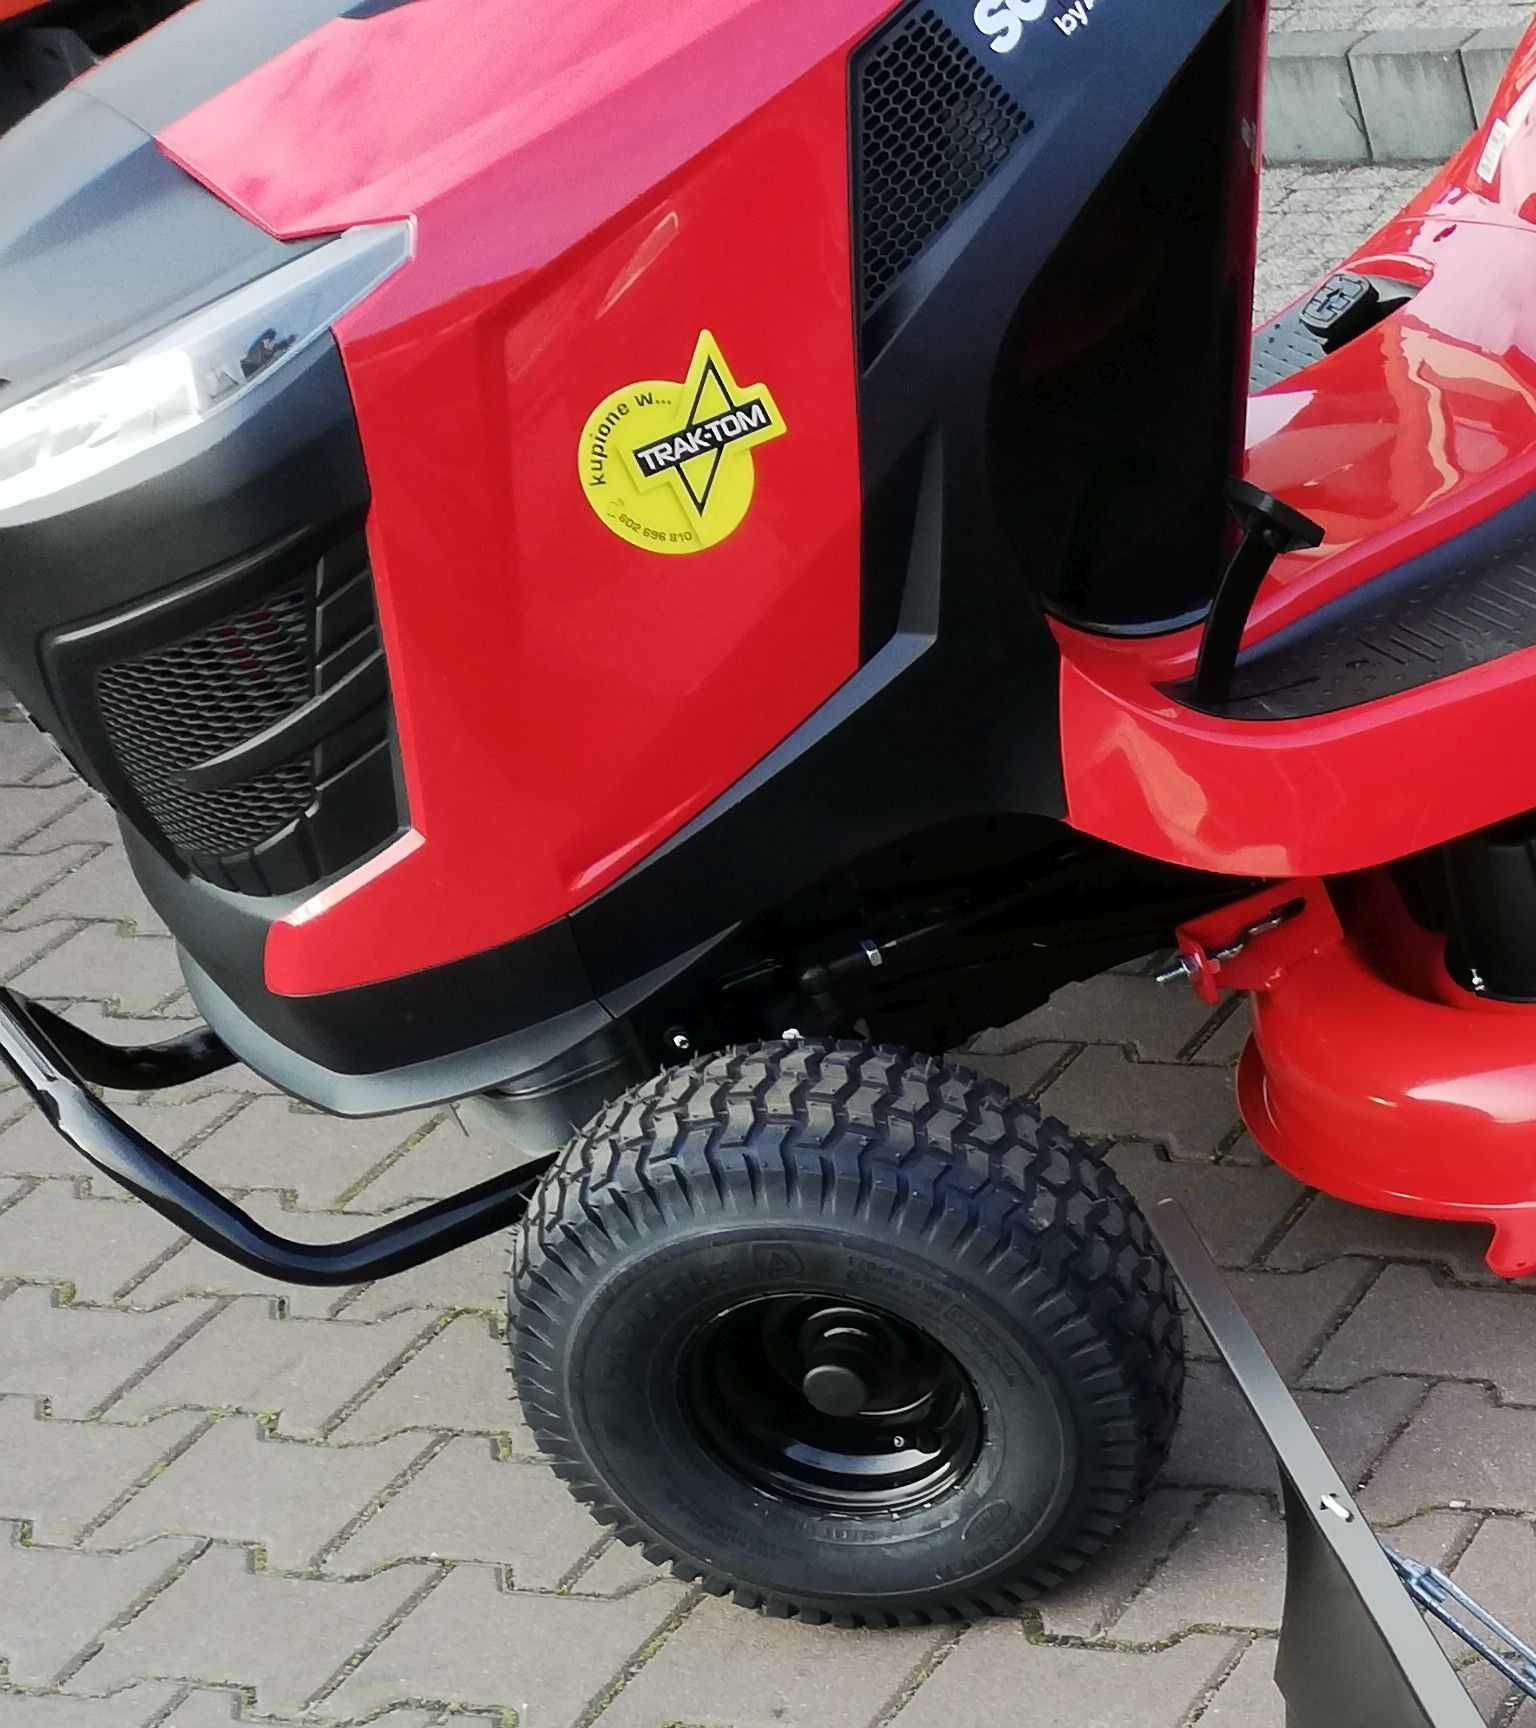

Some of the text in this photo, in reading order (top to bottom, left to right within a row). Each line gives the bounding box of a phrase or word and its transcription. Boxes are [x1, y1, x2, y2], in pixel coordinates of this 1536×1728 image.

[1053, 0, 1088, 36] by
[589, 401, 630, 486] kupione
[637, 403, 767, 471] TRAK-TOM
